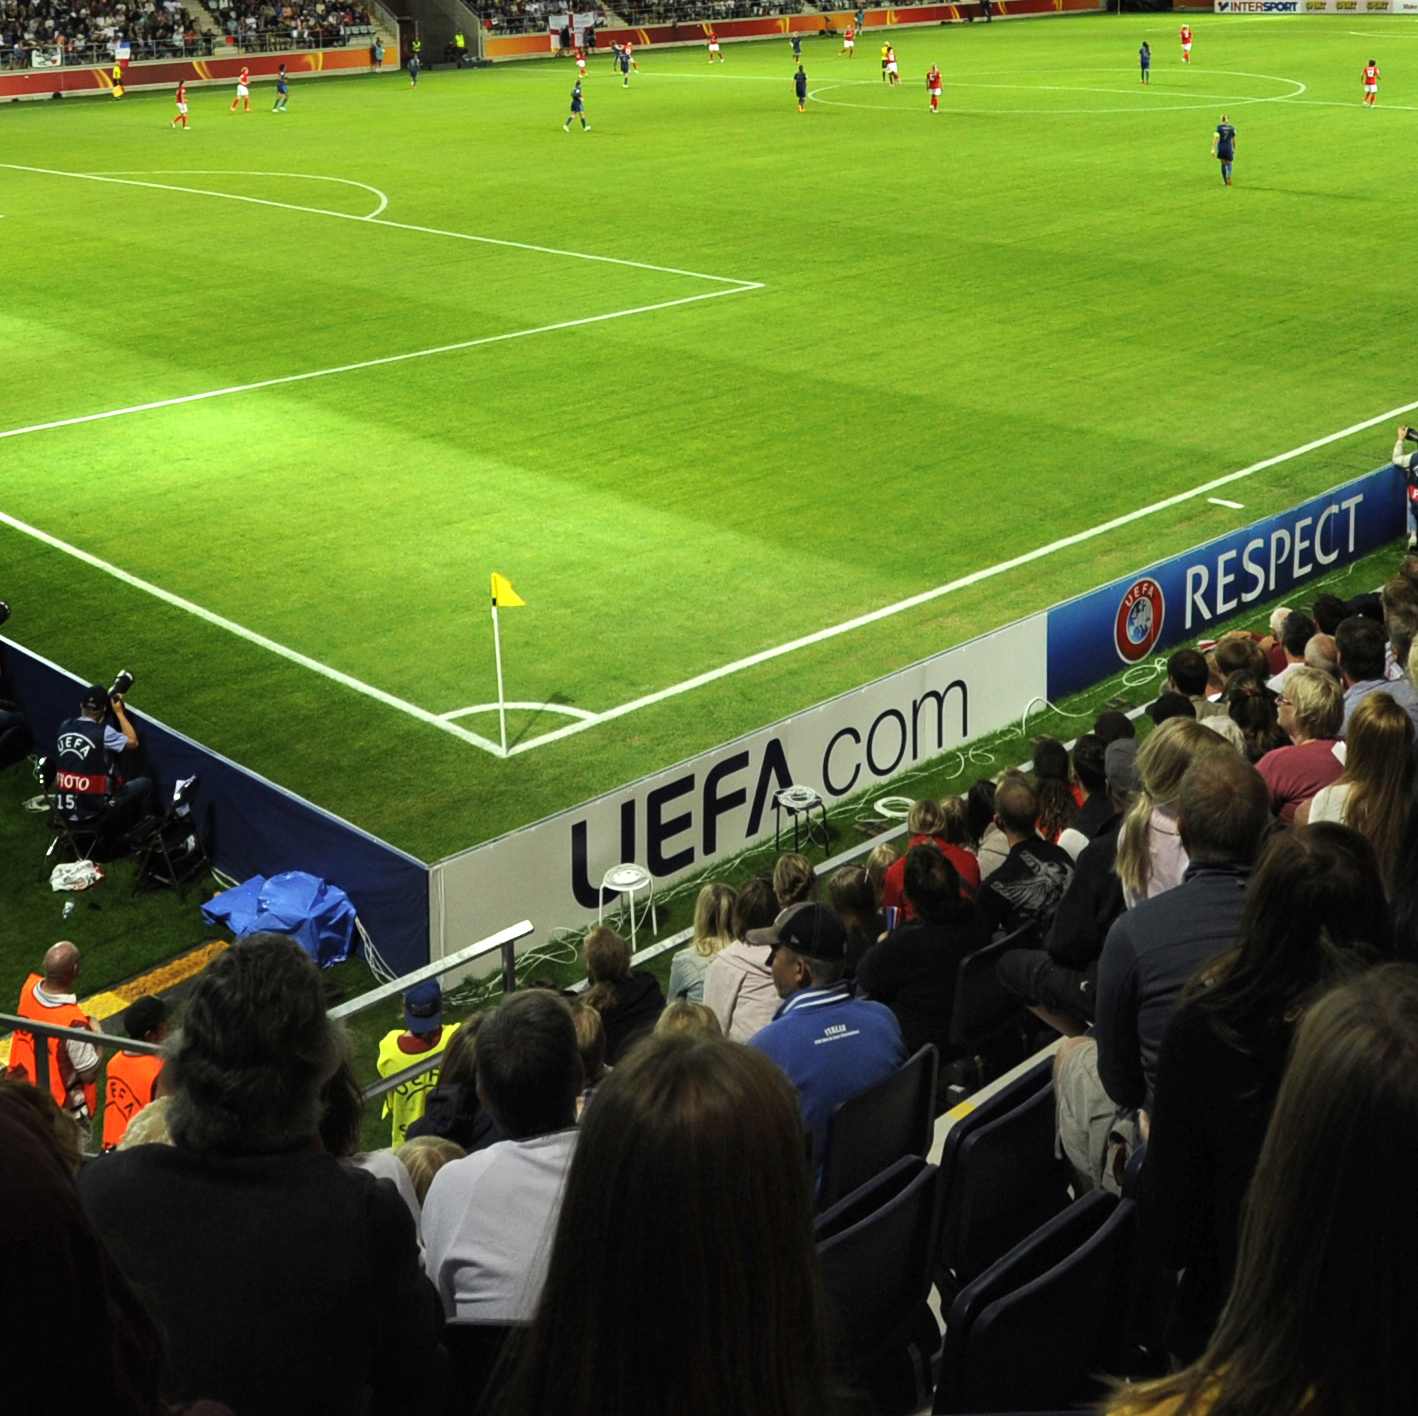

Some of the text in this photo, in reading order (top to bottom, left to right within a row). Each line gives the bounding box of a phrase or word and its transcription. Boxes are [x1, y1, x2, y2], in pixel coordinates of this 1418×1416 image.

[1230, 1, 1298, 12] INTERSPORT
[1125, 582, 1154, 607] UEFA
[1185, 494, 1364, 629] RESPECT
[571, 679, 968, 909] UEFAcom
